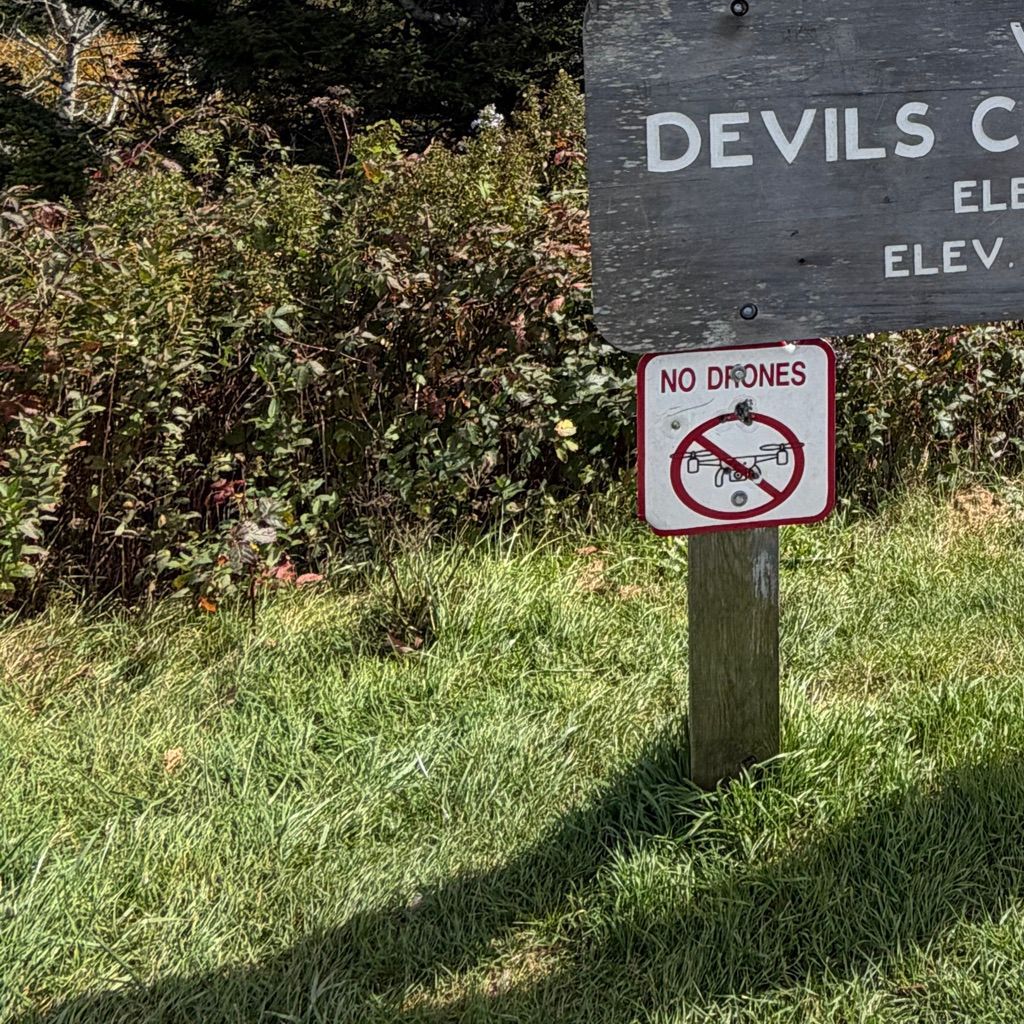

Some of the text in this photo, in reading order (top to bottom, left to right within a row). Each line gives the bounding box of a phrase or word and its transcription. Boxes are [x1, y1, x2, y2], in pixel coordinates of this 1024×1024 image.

[646, 101, 935, 173] DEVILS
[884, 237, 1015, 278] ELEV.
[660, 367, 697, 394] NO
